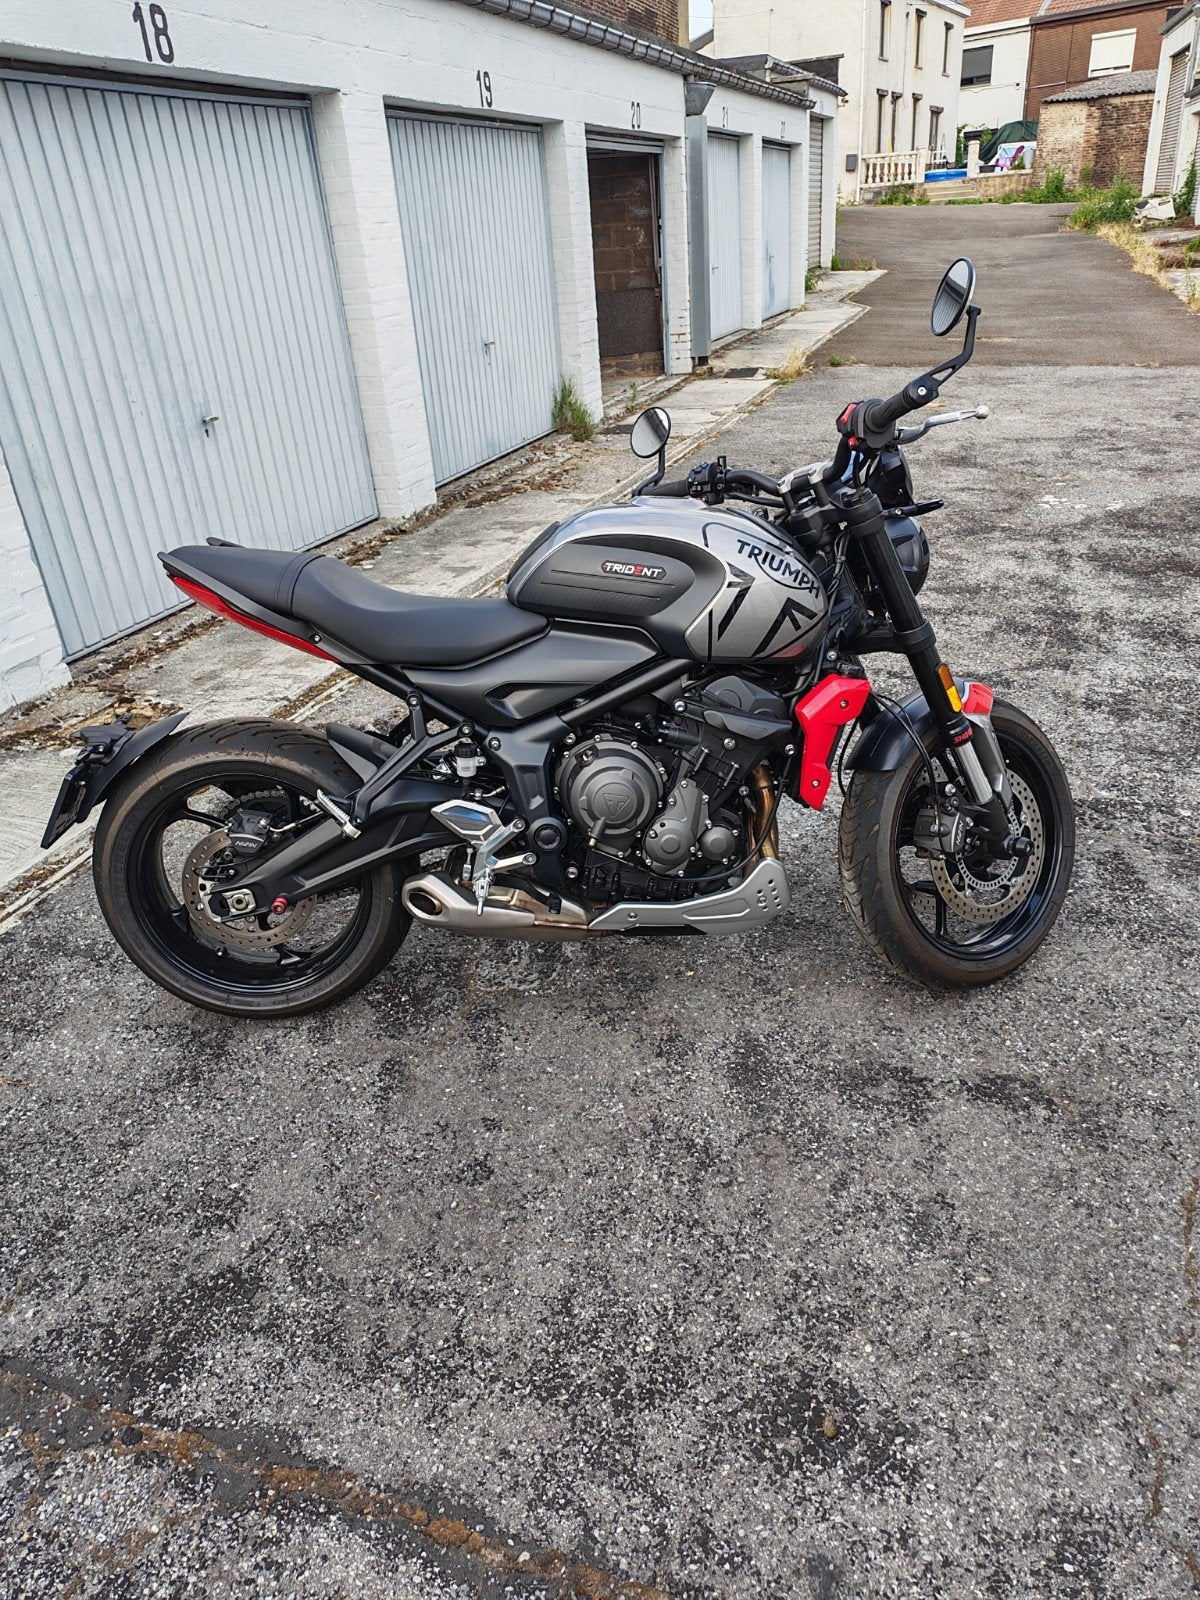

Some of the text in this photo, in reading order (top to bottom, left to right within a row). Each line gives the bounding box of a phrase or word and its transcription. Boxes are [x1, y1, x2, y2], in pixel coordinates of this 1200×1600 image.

[132, 1, 174, 64] 18
[476, 70, 492, 108] 19
[630, 101, 641, 129] 20
[722, 106, 729, 128] 21
[604, 561, 663, 578] TRIDENT
[737, 539, 820, 600] TRIUMPH
